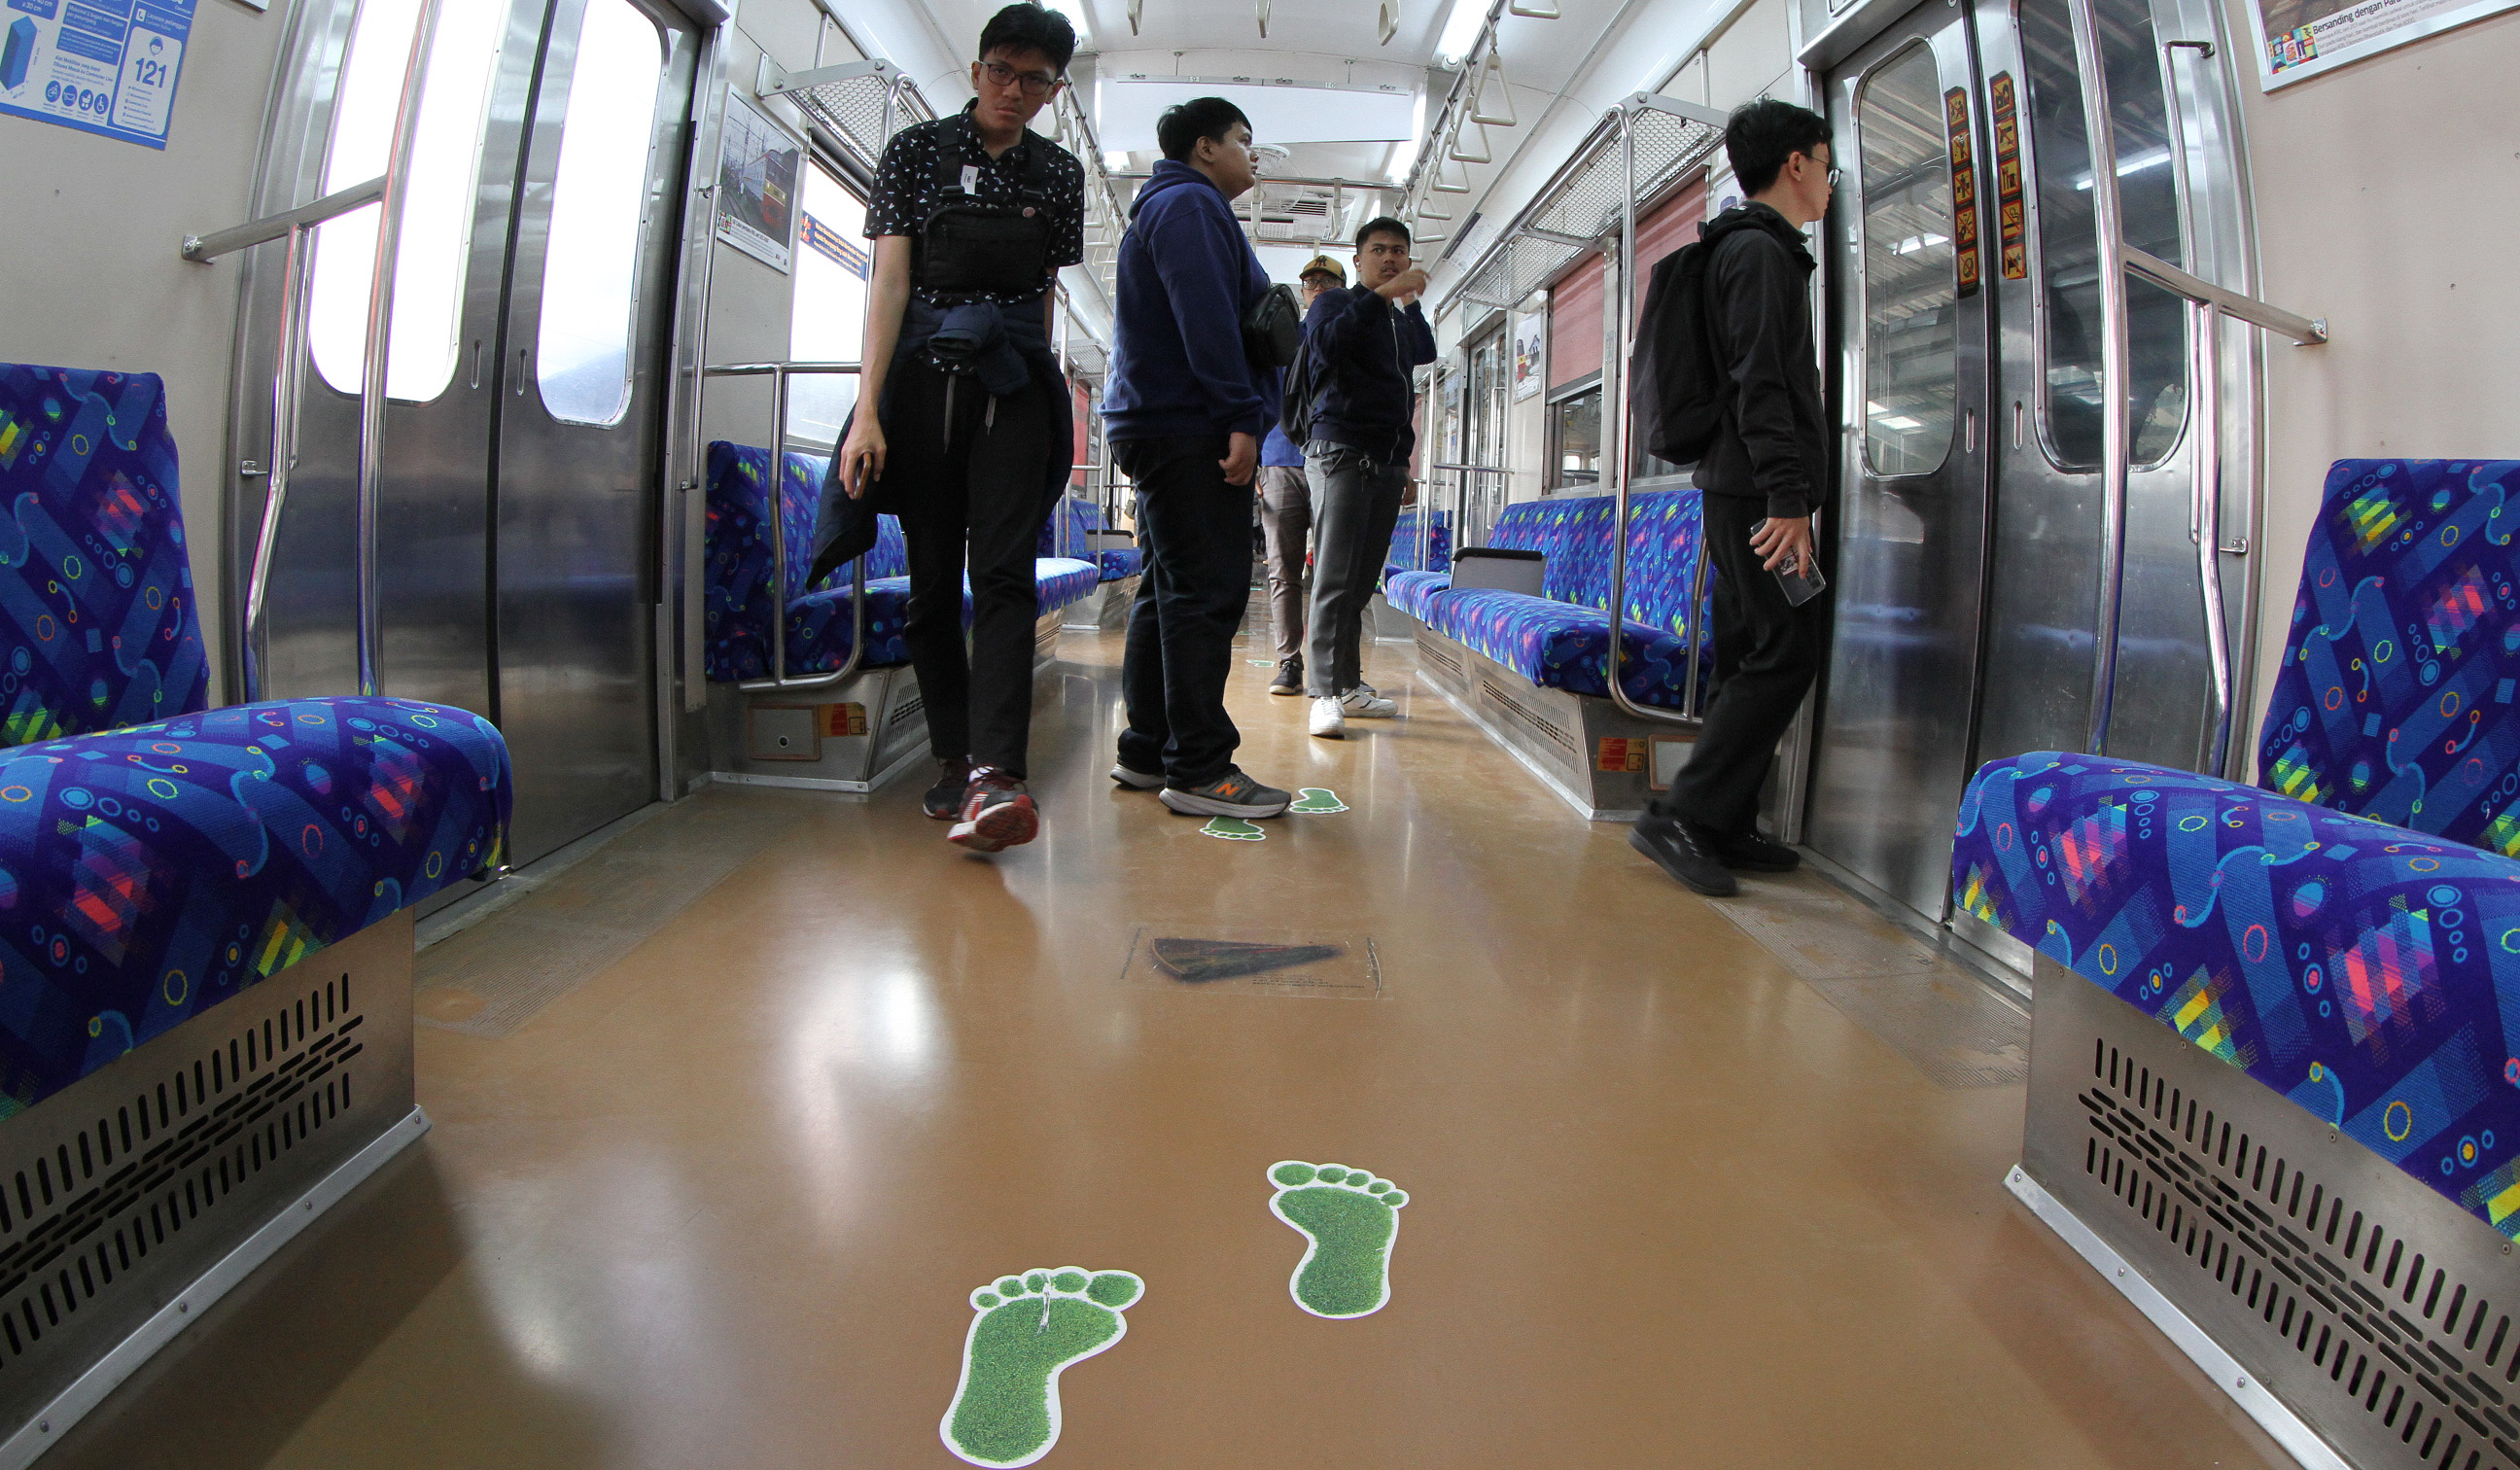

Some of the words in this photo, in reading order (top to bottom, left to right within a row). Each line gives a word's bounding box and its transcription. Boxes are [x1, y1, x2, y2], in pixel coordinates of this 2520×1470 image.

[2312, 13, 2355, 35] Bersanding
[2354, 1, 2383, 19] dengan
[136, 58, 167, 88] 121
[1214, 783, 1240, 796] N
